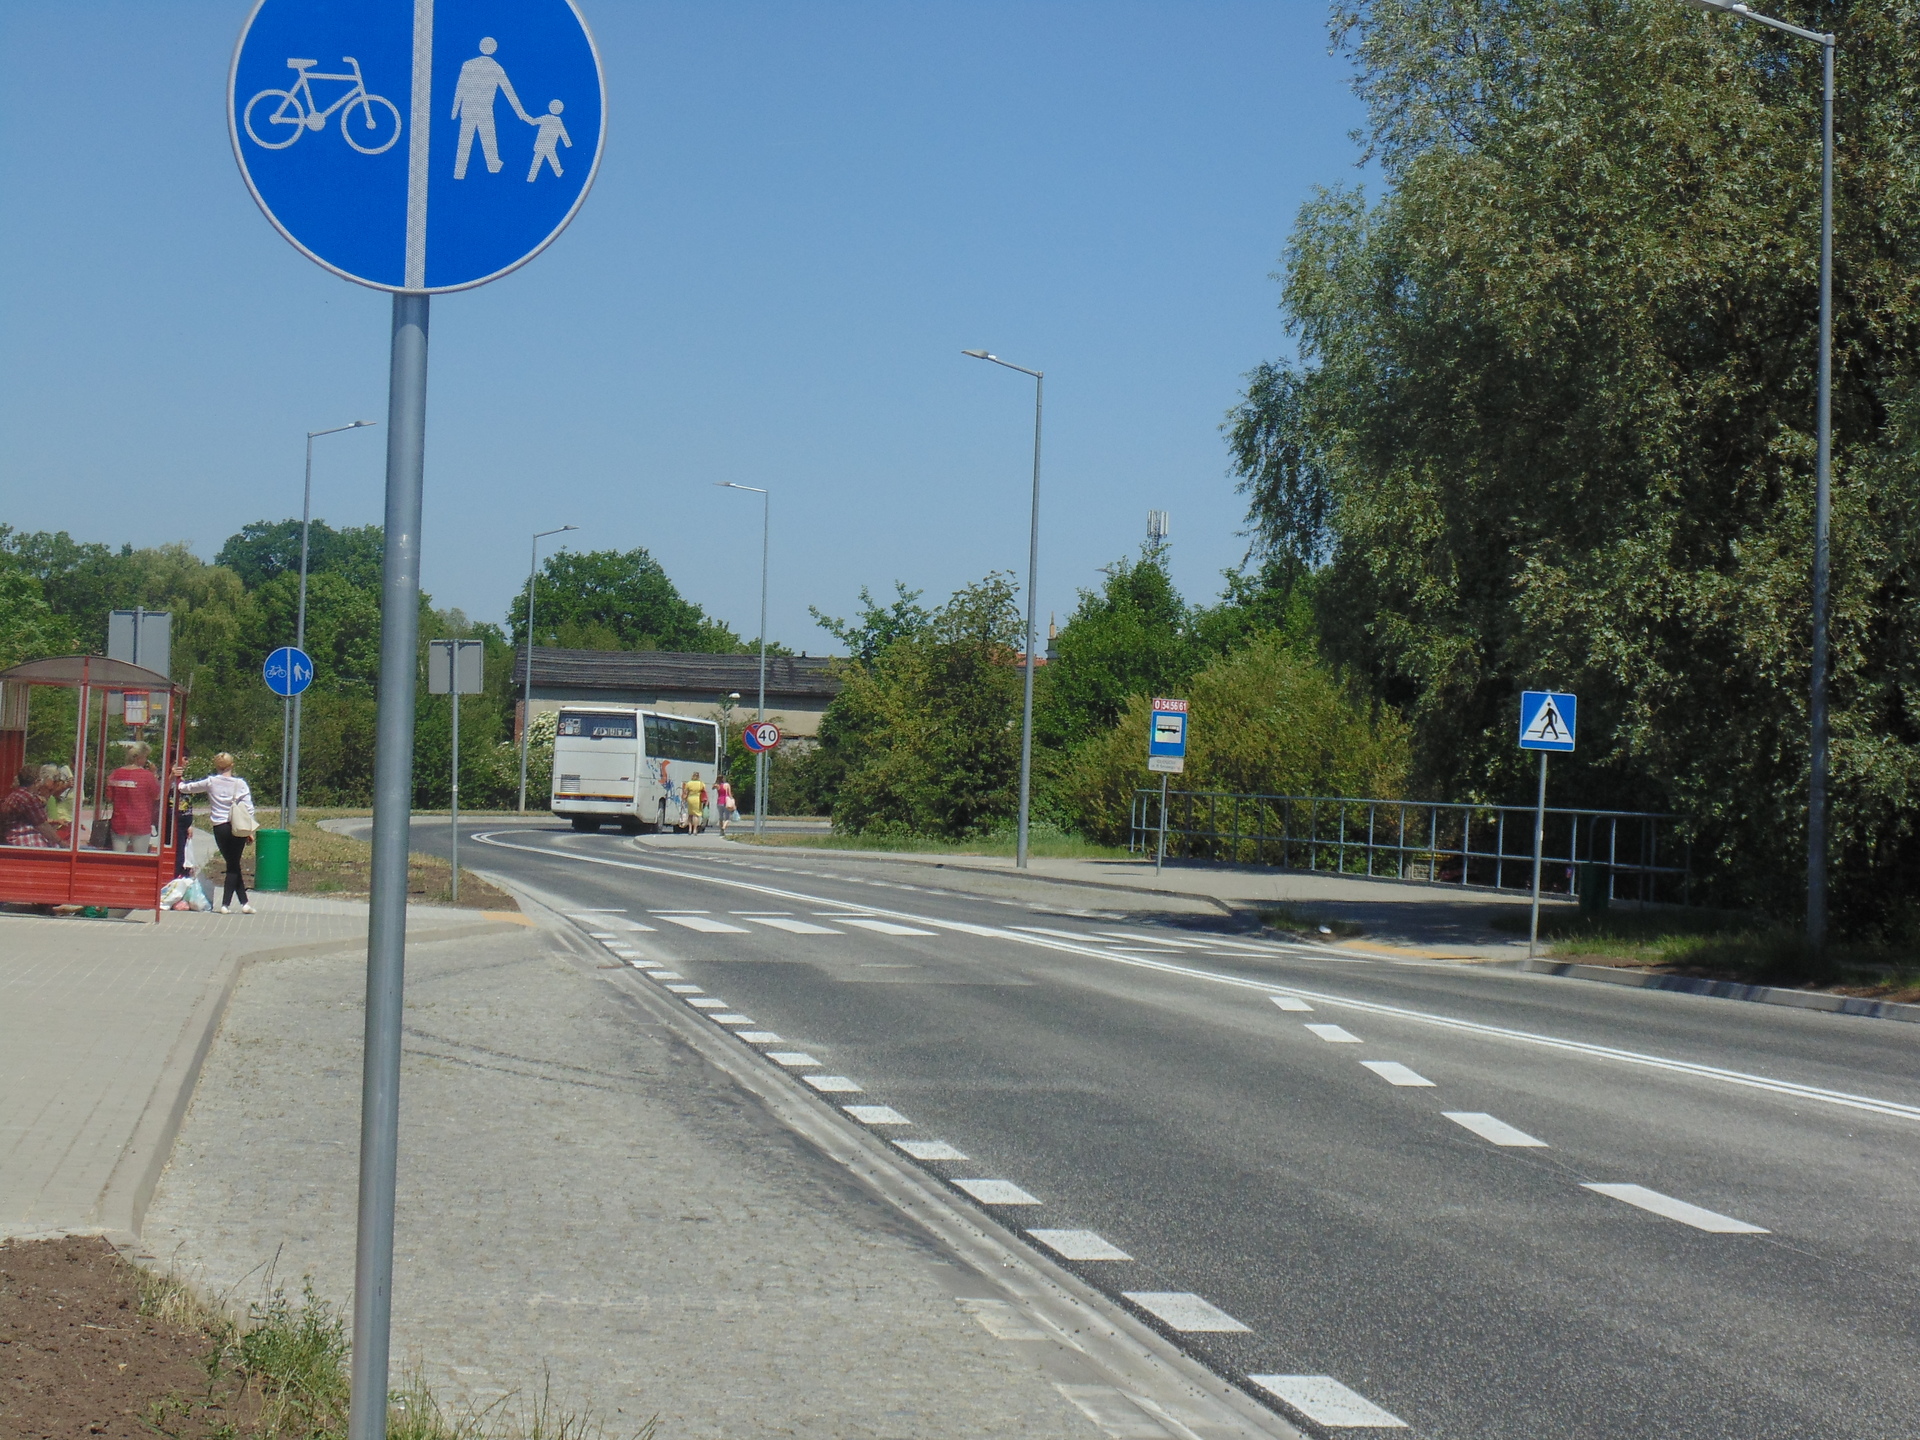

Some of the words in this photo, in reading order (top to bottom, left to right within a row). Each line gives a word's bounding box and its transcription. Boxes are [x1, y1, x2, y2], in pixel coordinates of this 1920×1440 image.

[1162, 700, 1169, 710] 54
[1170, 701, 1178, 710] 56
[1179, 702, 1187, 711] 61
[758, 730, 776, 742] 40
